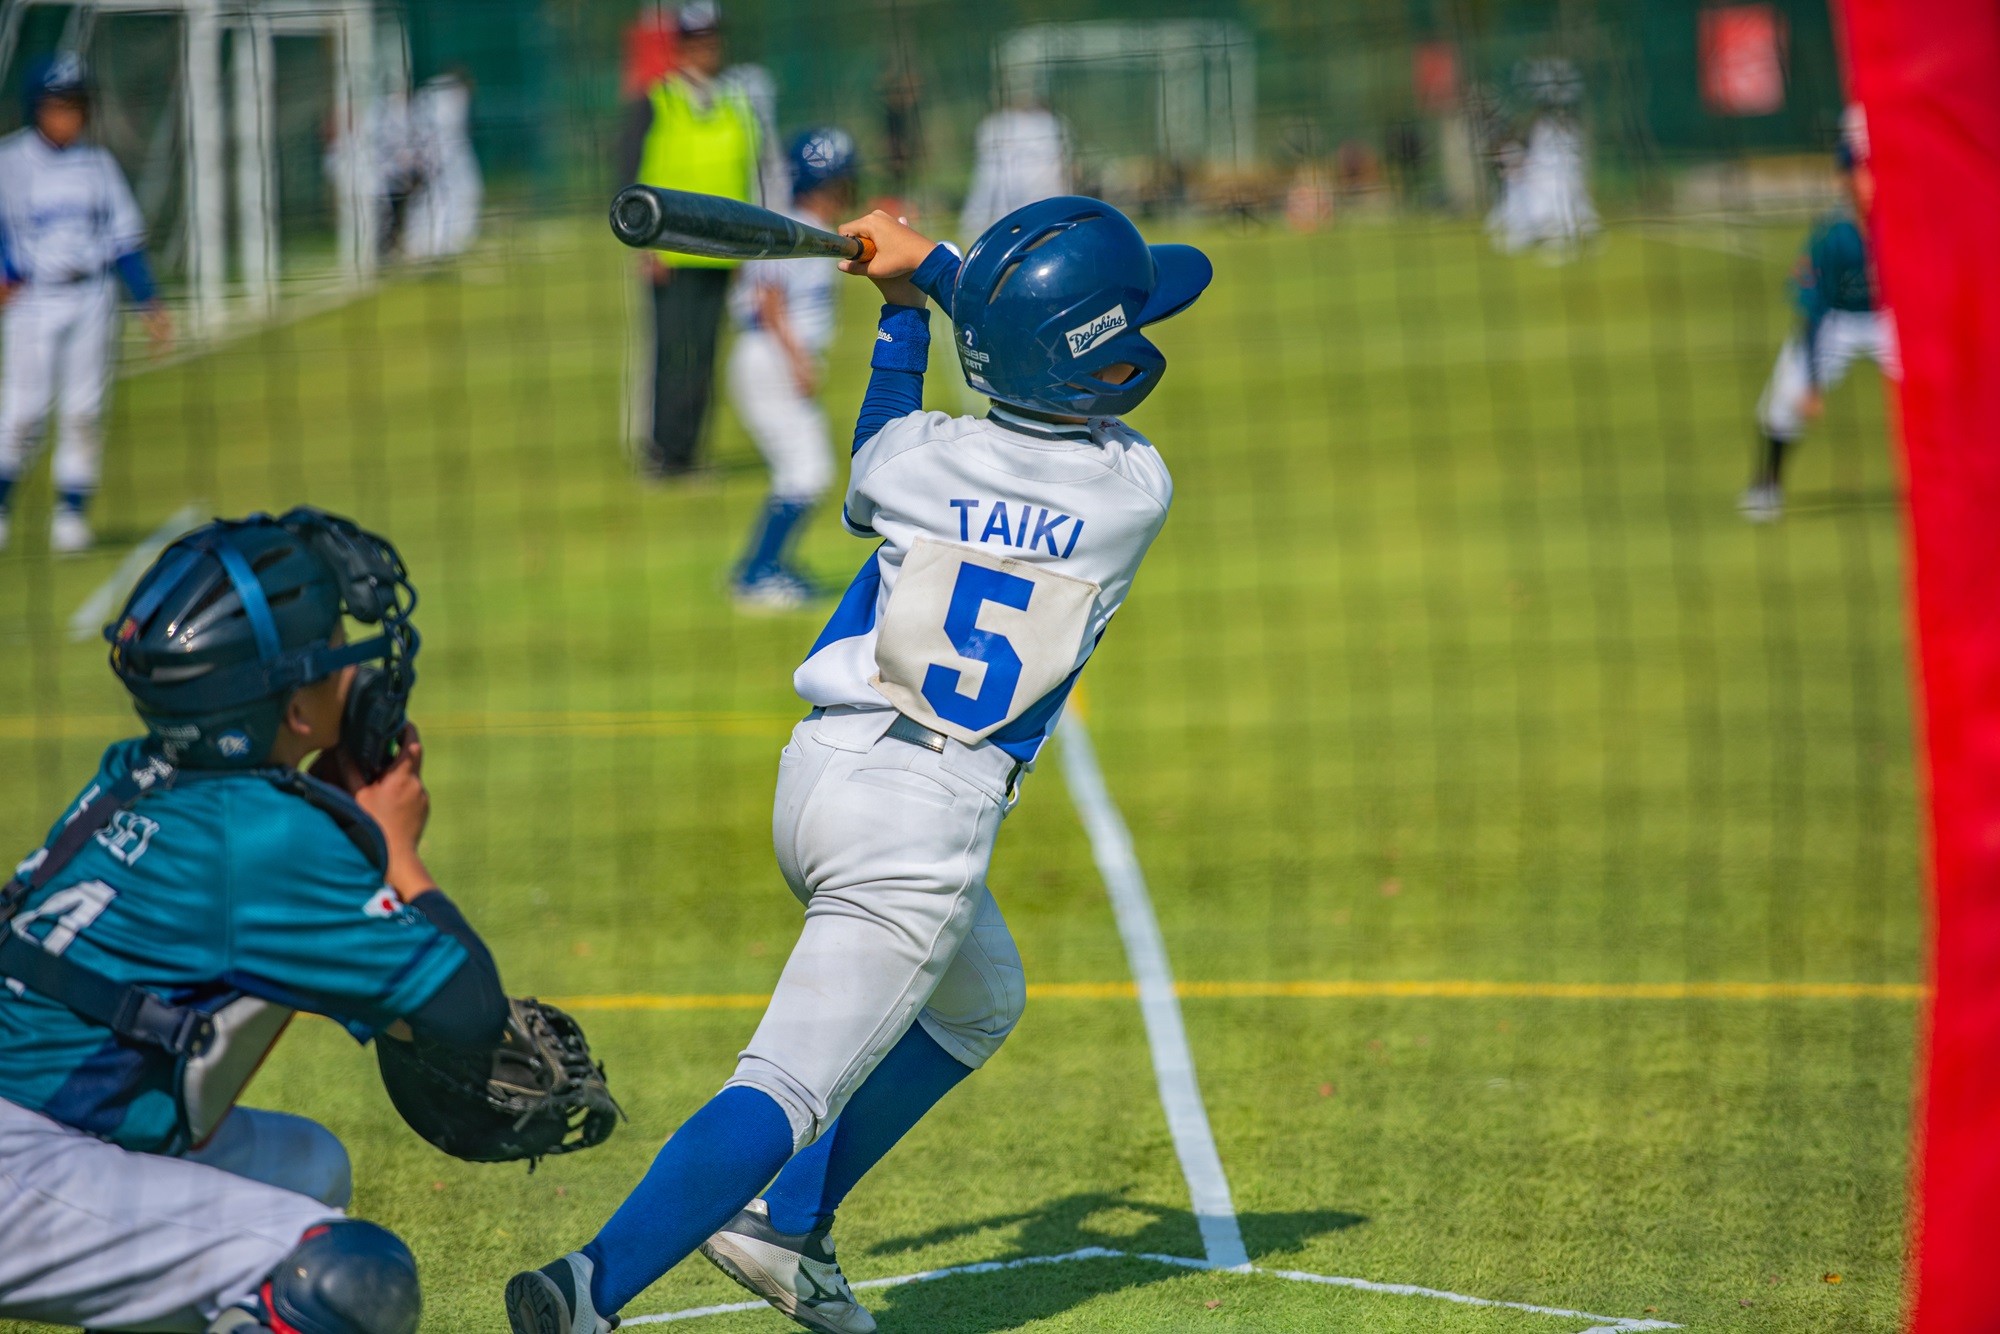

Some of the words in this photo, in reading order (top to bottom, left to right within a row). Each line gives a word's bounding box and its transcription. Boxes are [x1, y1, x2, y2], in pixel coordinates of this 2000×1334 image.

[965, 330, 973, 347] 2
[1069, 315, 1125, 353] Dolphins
[950, 498, 1085, 560] TAIKI
[921, 561, 1036, 732] 5
